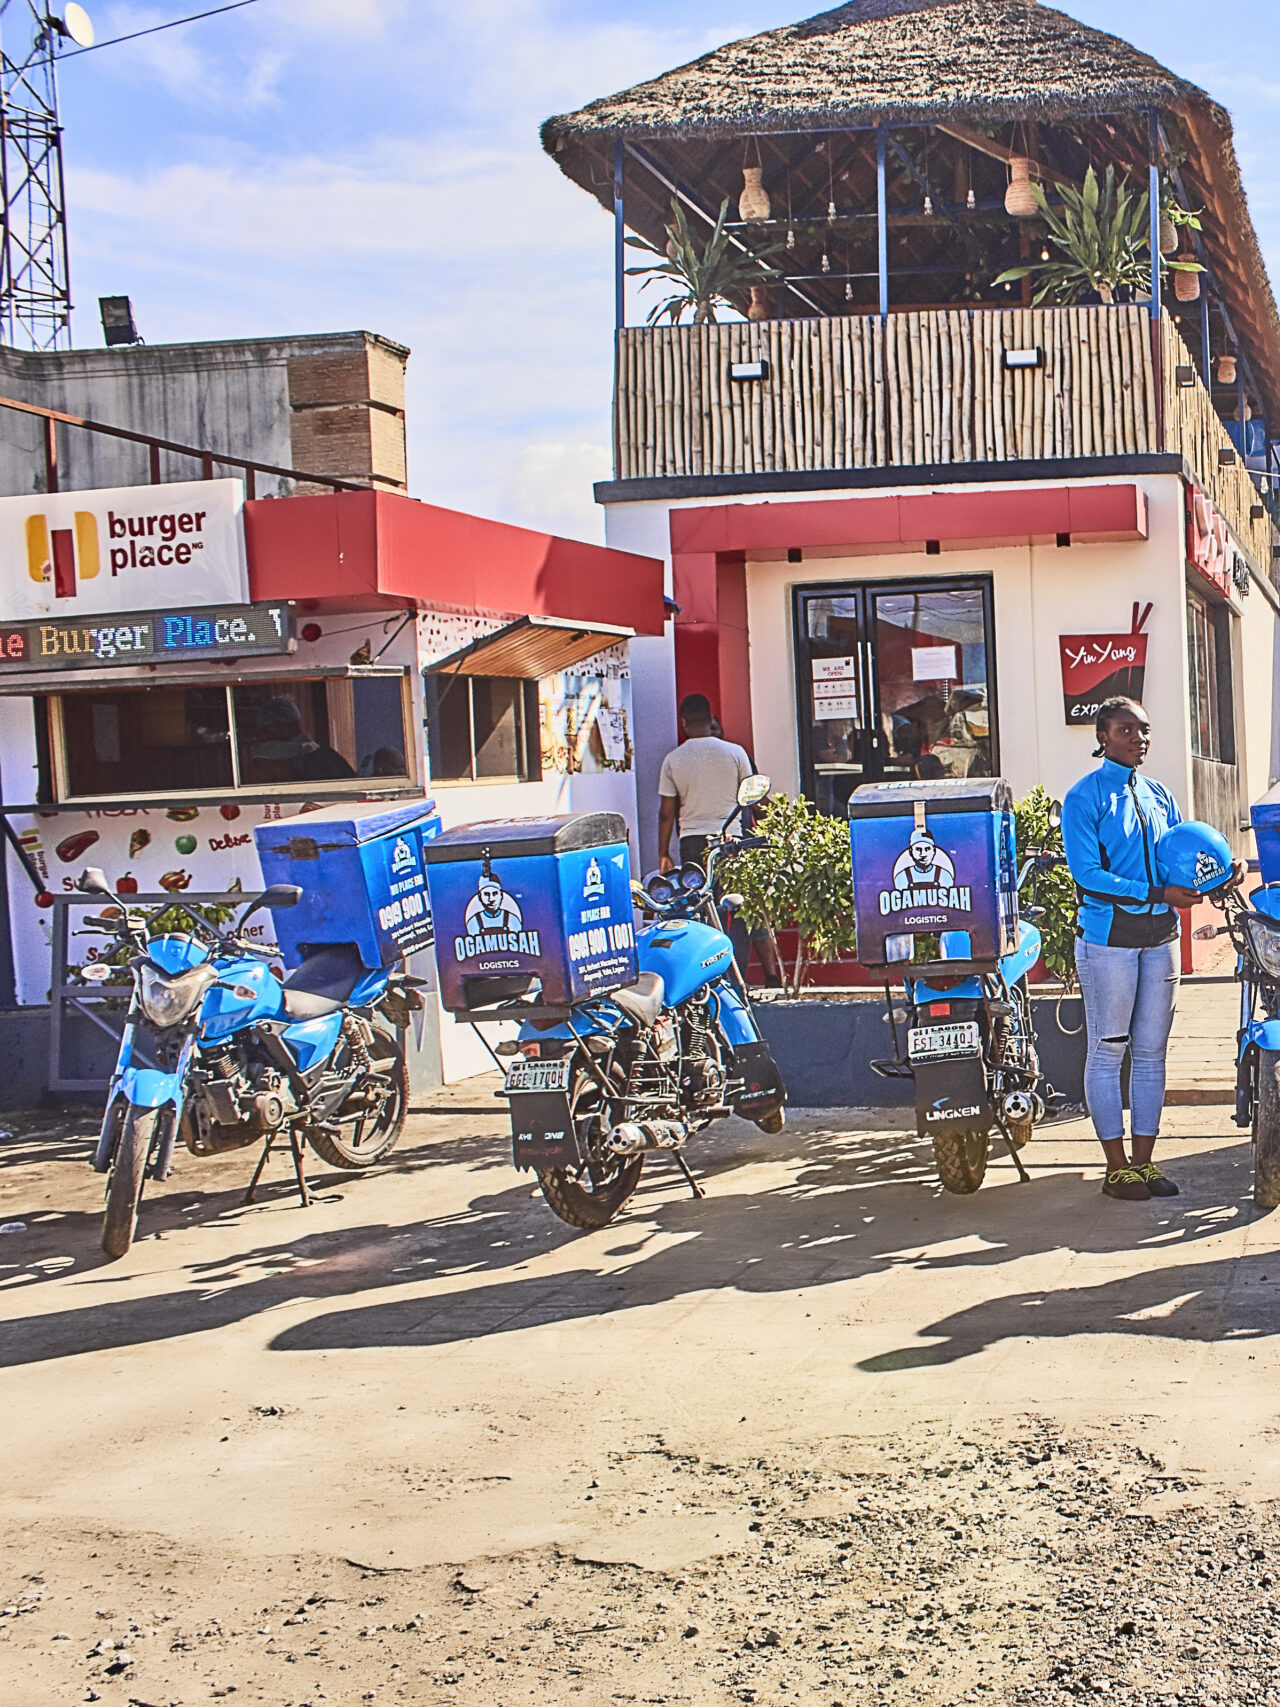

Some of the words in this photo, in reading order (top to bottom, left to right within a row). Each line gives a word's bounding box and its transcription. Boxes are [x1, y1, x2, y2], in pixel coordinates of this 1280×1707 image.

[107, 510, 206, 543] burger
[110, 540, 192, 576] place
[40, 624, 149, 658] Burger
[162, 615, 256, 647] Place.
[1071, 704, 1102, 717] EXP
[208, 833, 252, 851] Deluxe
[1192, 865, 1226, 888] OGAMUSAH
[880, 886, 972, 916] OGAMUSAH
[904, 914, 947, 925] LOGISTICS
[455, 931, 541, 962] OGAMUSAH
[608, 923, 634, 951] 1001
[479, 960, 519, 970] LOGISTICS
[914, 1032, 973, 1050] FST-344QJ
[925, 1105, 981, 1122] LINGKEN
